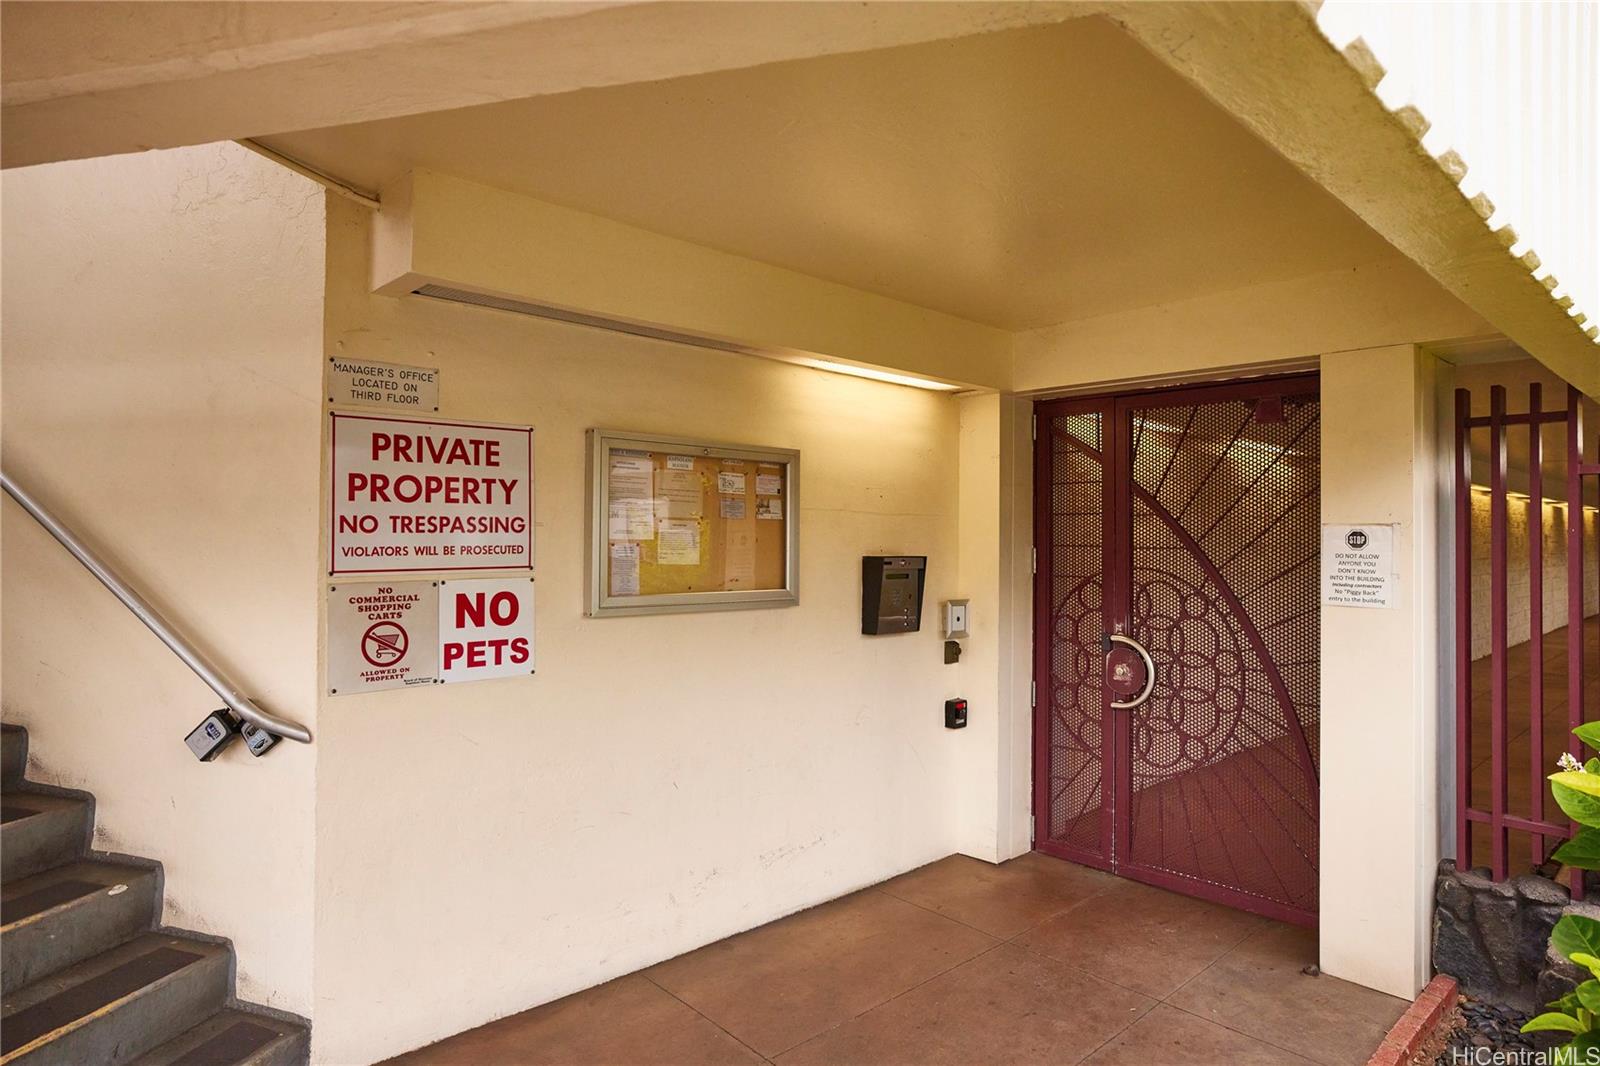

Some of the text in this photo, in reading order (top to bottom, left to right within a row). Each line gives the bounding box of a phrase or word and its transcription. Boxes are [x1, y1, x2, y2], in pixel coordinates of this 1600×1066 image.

[333, 363, 434, 383] MANAGER'S OFFICE
[352, 378, 417, 392] LOCATED ON
[350, 389, 419, 405] THIRD FLOOR
[372, 432, 500, 467] PRIVATE
[348, 472, 518, 505] PROPERTY
[339, 514, 526, 534] NO TRESPASSING
[1349, 535, 1366, 544] STOP
[342, 544, 524, 557] VIOLATORS WILL BE PROSECUTED
[349, 594, 420, 604] COMMERCIAL
[1362, 597, 1386, 605] building
[358, 603, 412, 612] SHOPPING
[456, 591, 519, 628] NO
[368, 612, 402, 620] CARTS
[443, 637, 529, 670] PETS
[360, 668, 397, 677] ALLOWED
[365, 674, 405, 682] PROPERTY
